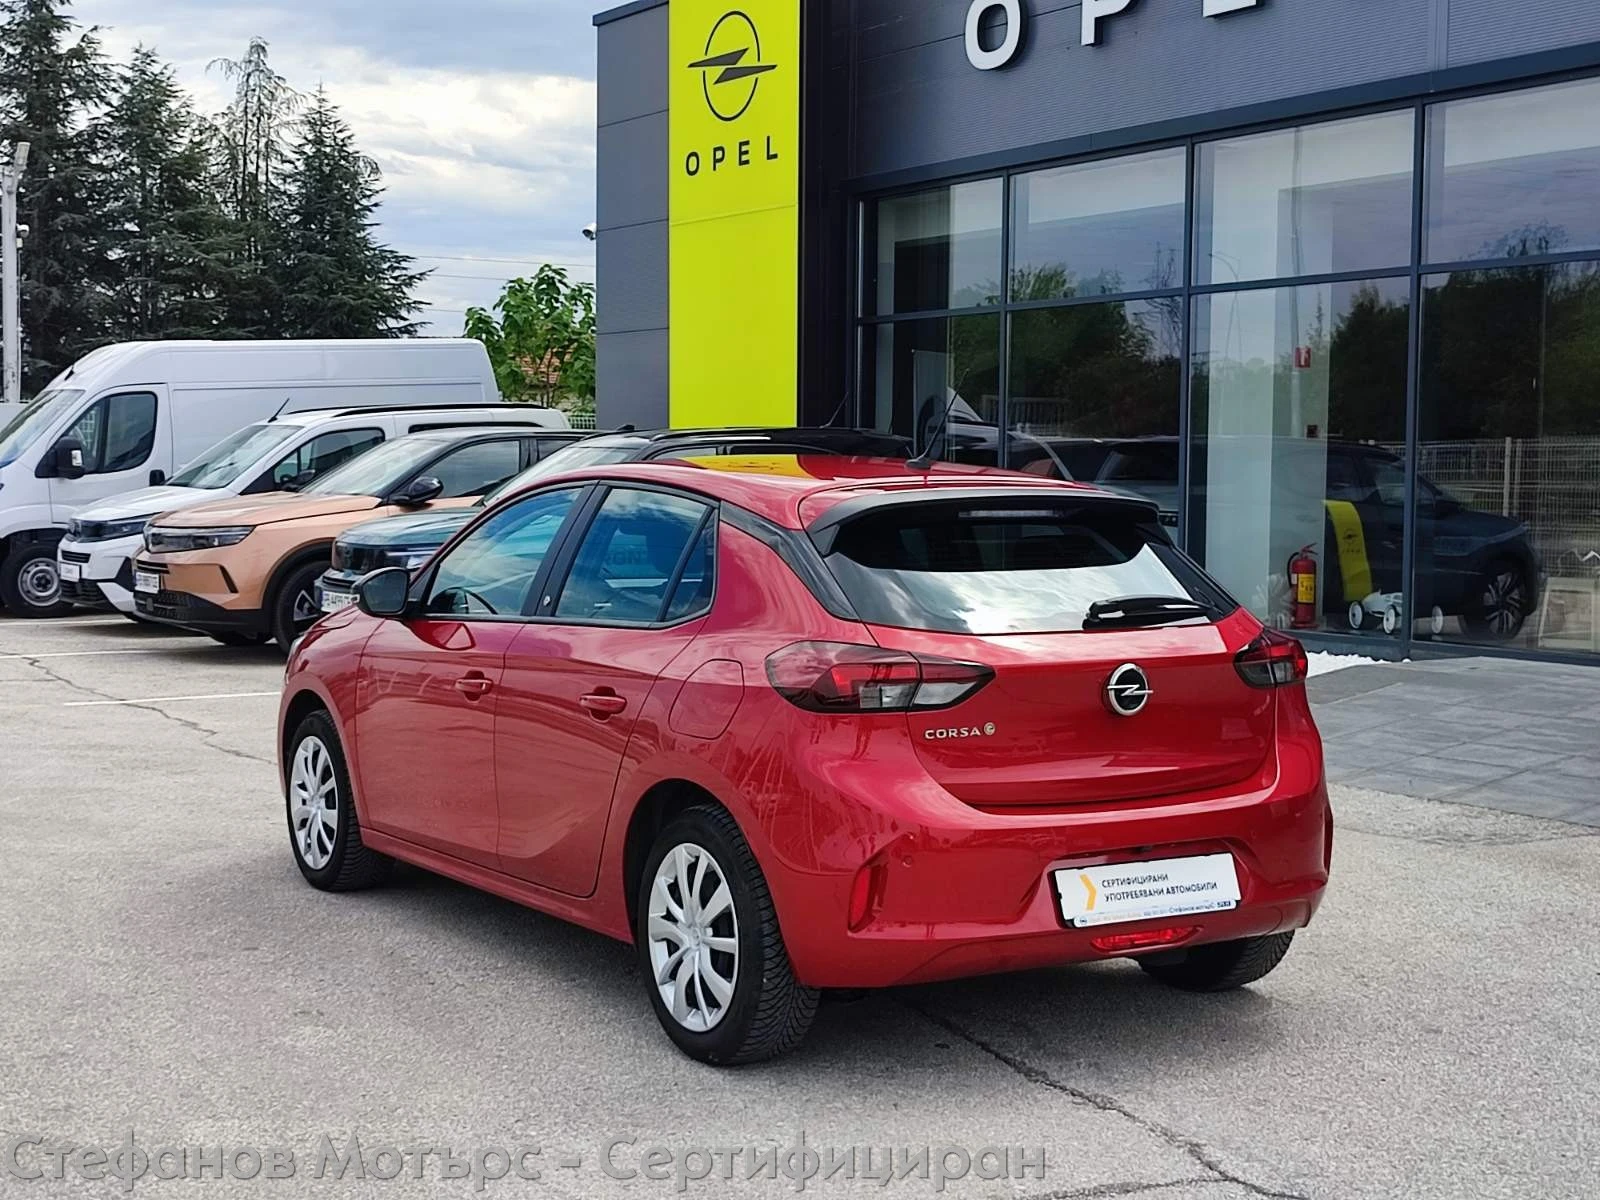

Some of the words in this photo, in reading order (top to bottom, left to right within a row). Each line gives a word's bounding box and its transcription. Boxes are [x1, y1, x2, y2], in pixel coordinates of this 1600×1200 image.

[685, 135, 778, 177] OPEL
[924, 726, 981, 739] CORSA
[1101, 873, 1169, 888] СЕРТИФИЦИРАНИ
[1104, 888, 1165, 902] УПОТРЕБЯВАНИ
[1165, 881, 1218, 896] АВТОМОБИЛИ
